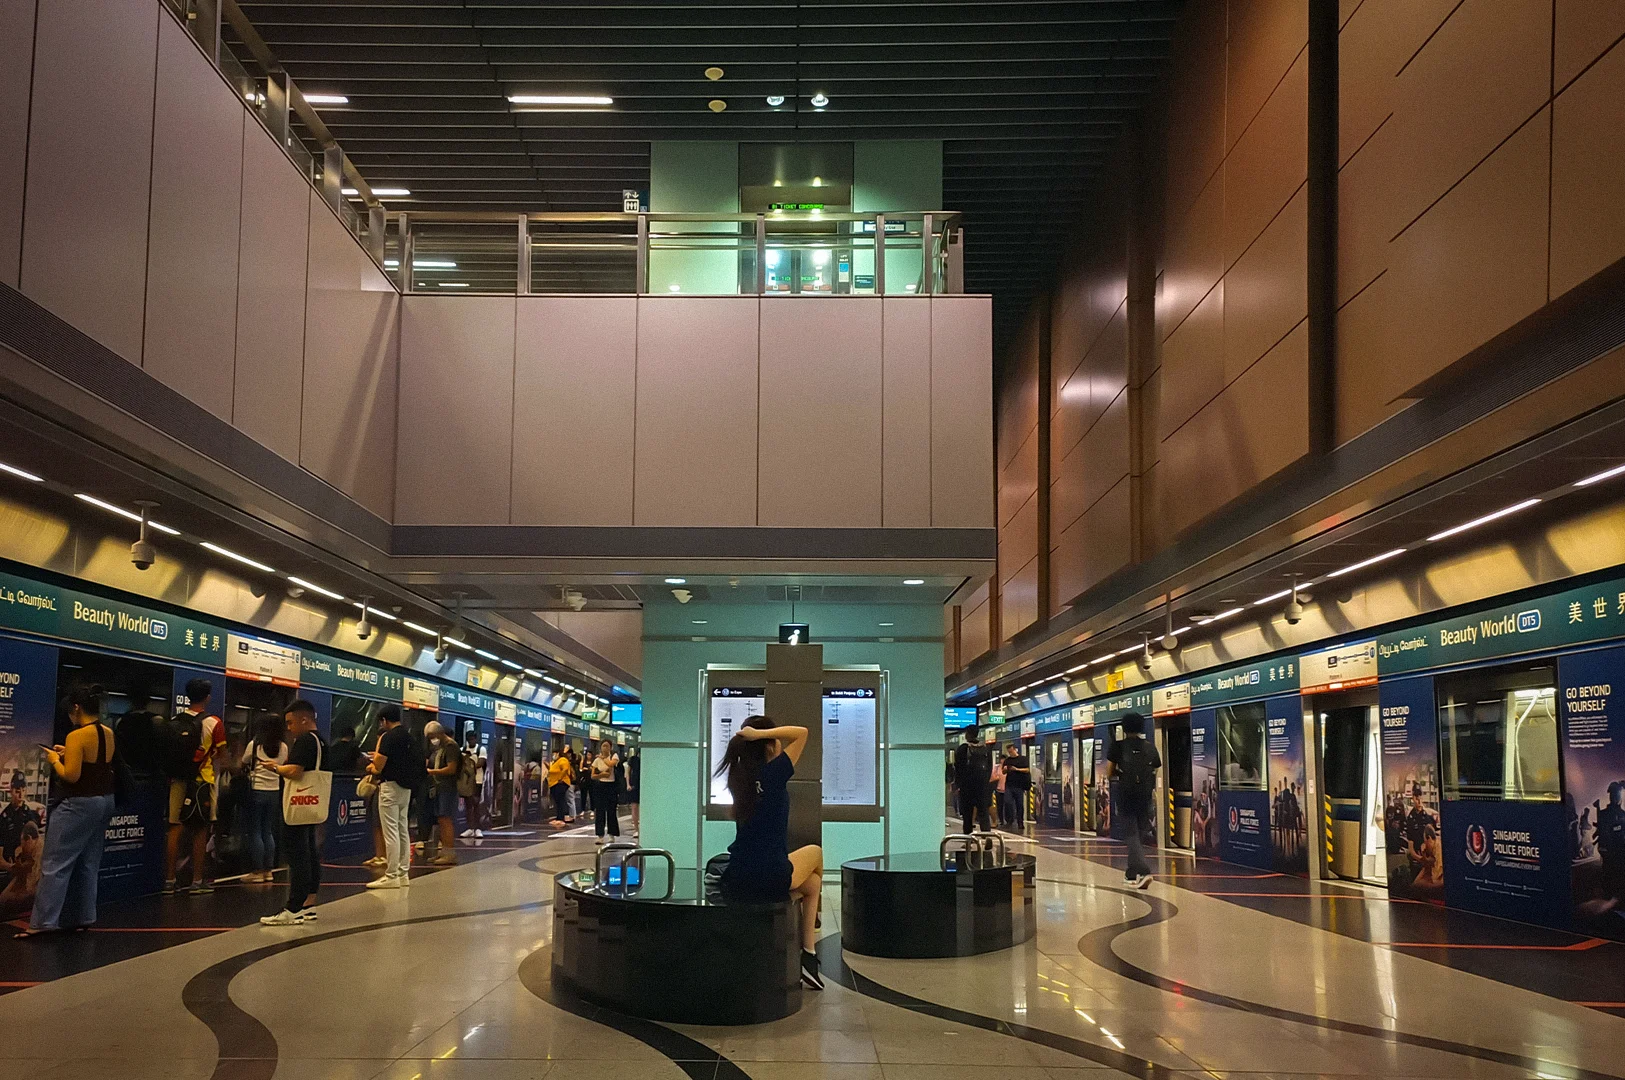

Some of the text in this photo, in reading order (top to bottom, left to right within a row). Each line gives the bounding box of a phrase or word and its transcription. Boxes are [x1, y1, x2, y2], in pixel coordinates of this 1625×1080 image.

[73, 601, 149, 635] Beauty World
[1522, 615, 1536, 627] DT5
[1440, 613, 1516, 646] Beauty World
[184, 628, 220, 652] 美世界
[337, 664, 370, 683] Beauty World
[1217, 671, 1250, 690] Beauty World
[1566, 684, 1611, 699] GO BEYOND
[1383, 705, 1410, 716] GO BEYOND
[1566, 699, 1607, 713] YOURSELF
[1383, 717, 1407, 727] YOURSELF
[105, 826, 144, 840] POLICE FORCE
[1492, 829, 1531, 843] SINGAPORE
[1494, 843, 1540, 858] POLICE FORCE
